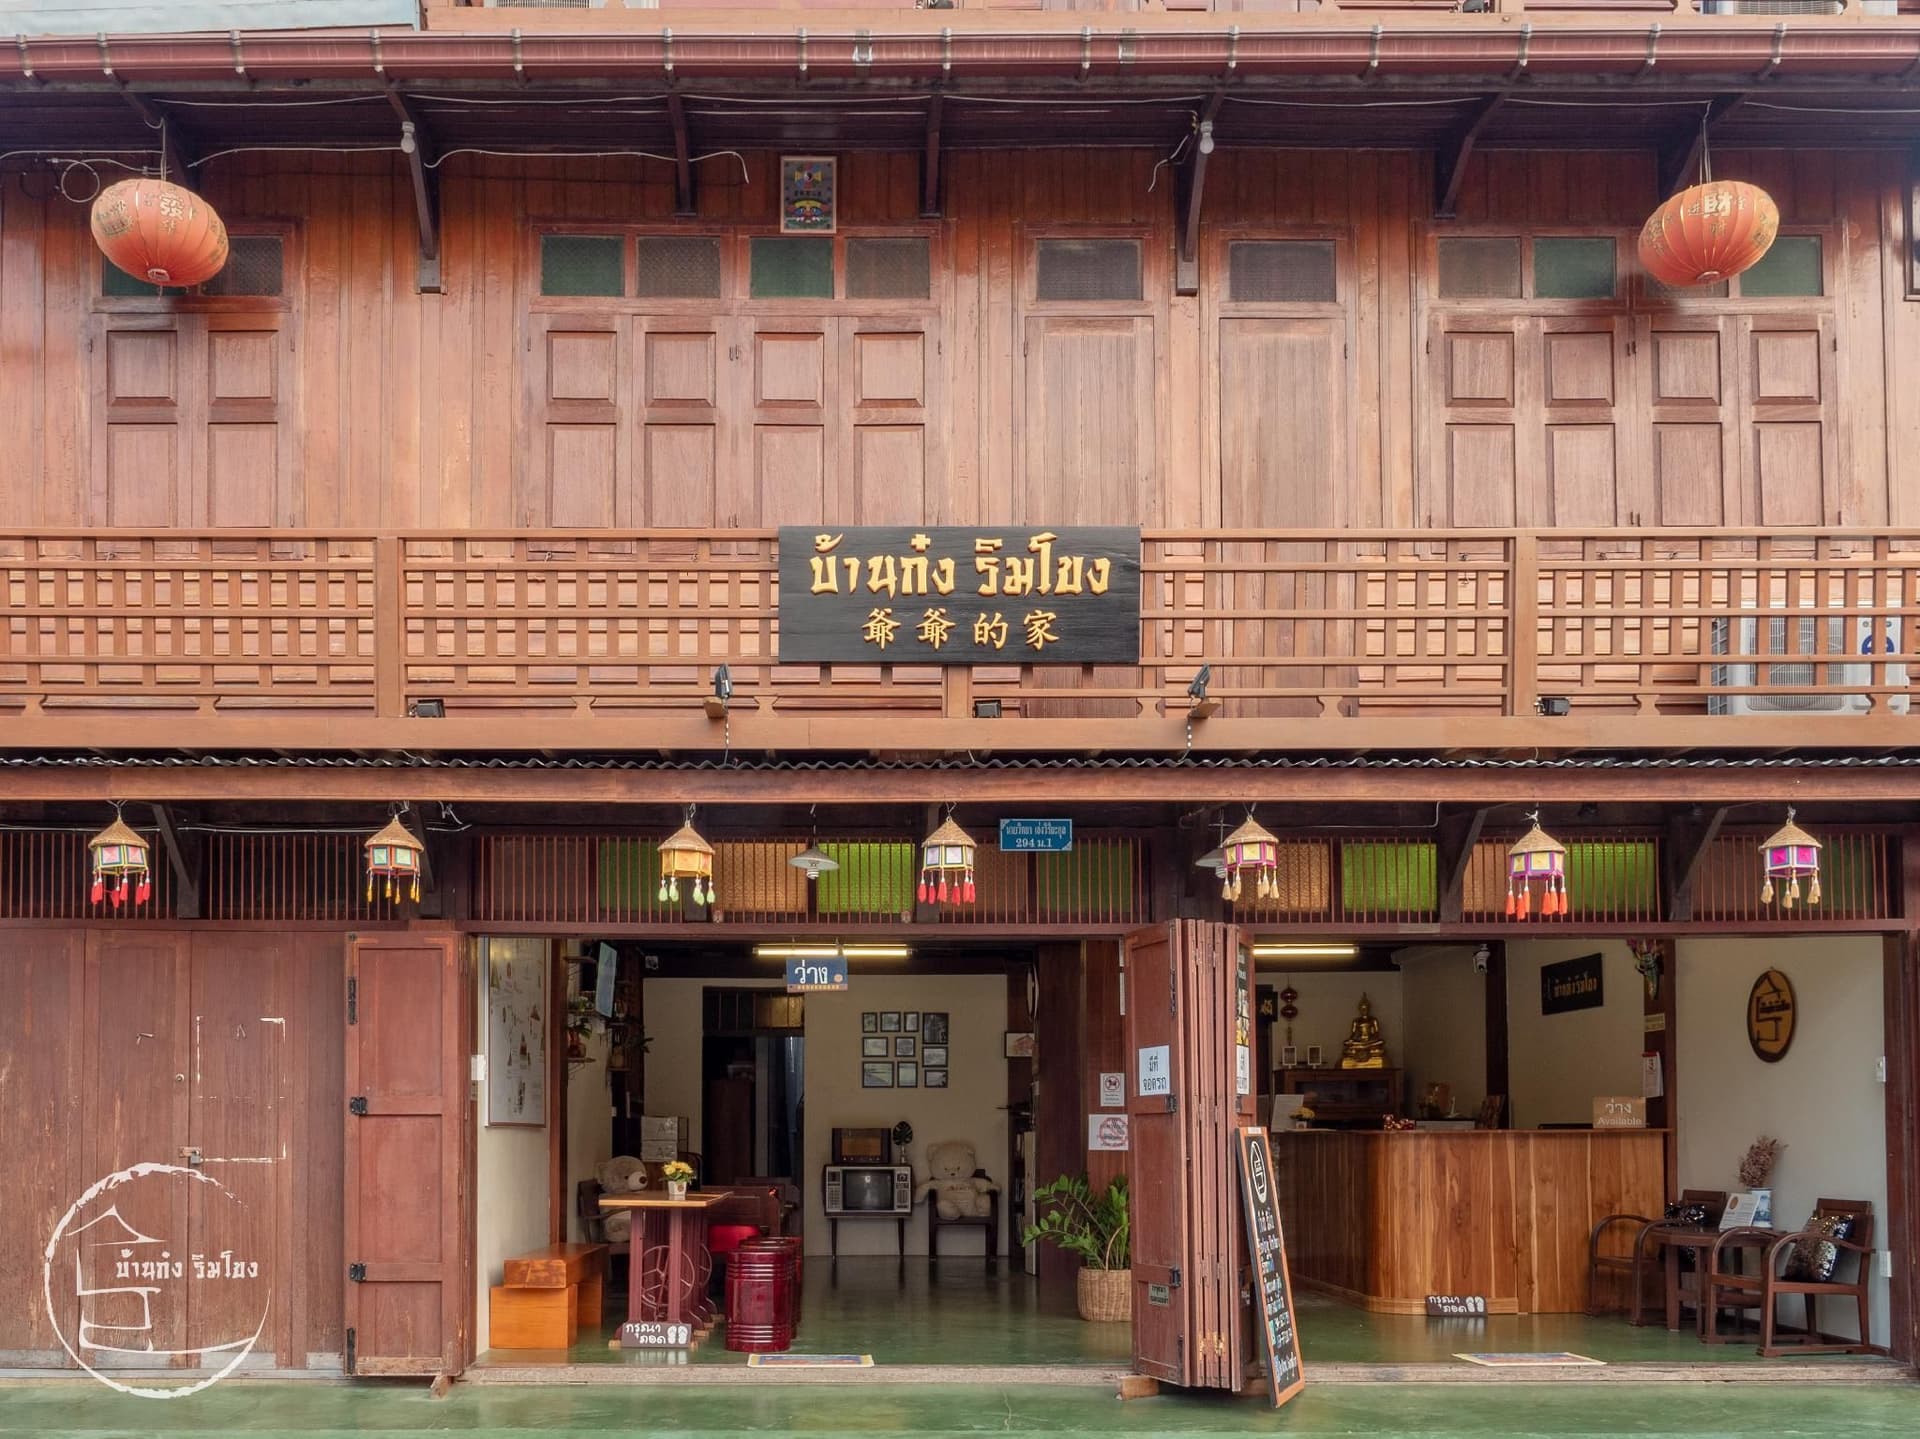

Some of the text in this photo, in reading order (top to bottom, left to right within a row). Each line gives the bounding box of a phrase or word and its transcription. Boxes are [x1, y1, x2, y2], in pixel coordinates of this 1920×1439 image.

[810, 532, 1110, 599] บ้านก๋ง ริมโขง
[862, 608, 1060, 650] 爺爺的家
[795, 959, 828, 984] ว่าง
[1605, 1098, 1632, 1114] ว่าง
[1597, 1116, 1642, 1127] Available
[1428, 1296, 1460, 1309] กรุณา
[626, 1323, 661, 1339] กรุณา
[640, 1335, 666, 1344] ถอด
